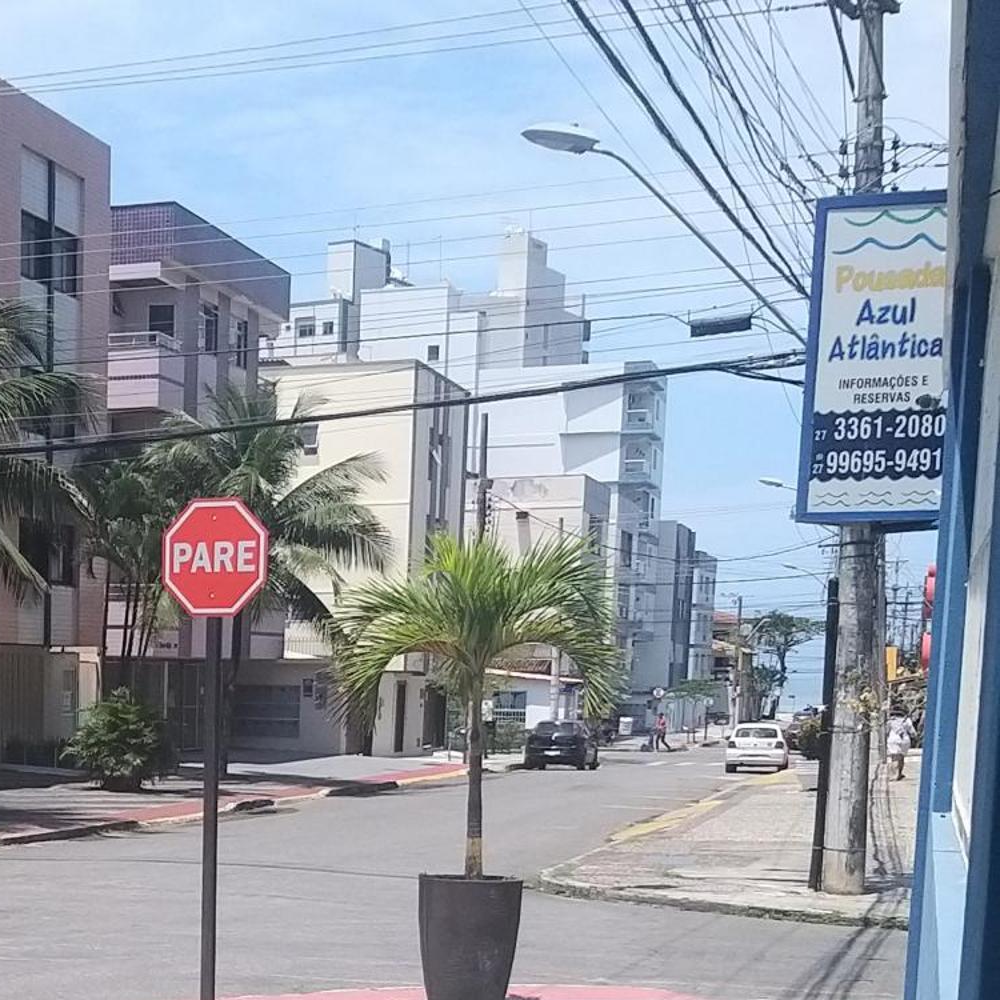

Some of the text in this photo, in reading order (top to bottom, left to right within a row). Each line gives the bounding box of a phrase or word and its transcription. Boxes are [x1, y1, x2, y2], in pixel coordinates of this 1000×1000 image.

[836, 261, 946, 293] Pousada
[856, 297, 916, 326] Azul
[828, 331, 944, 362] Atlântica
[838, 374, 929, 390] INFORMAÇÕES E
[853, 392, 911, 404] RESERVAS
[814, 414, 947, 441] 27 3361-2080
[825, 447, 942, 475] 99695-9491
[172, 540, 257, 574] PARE
